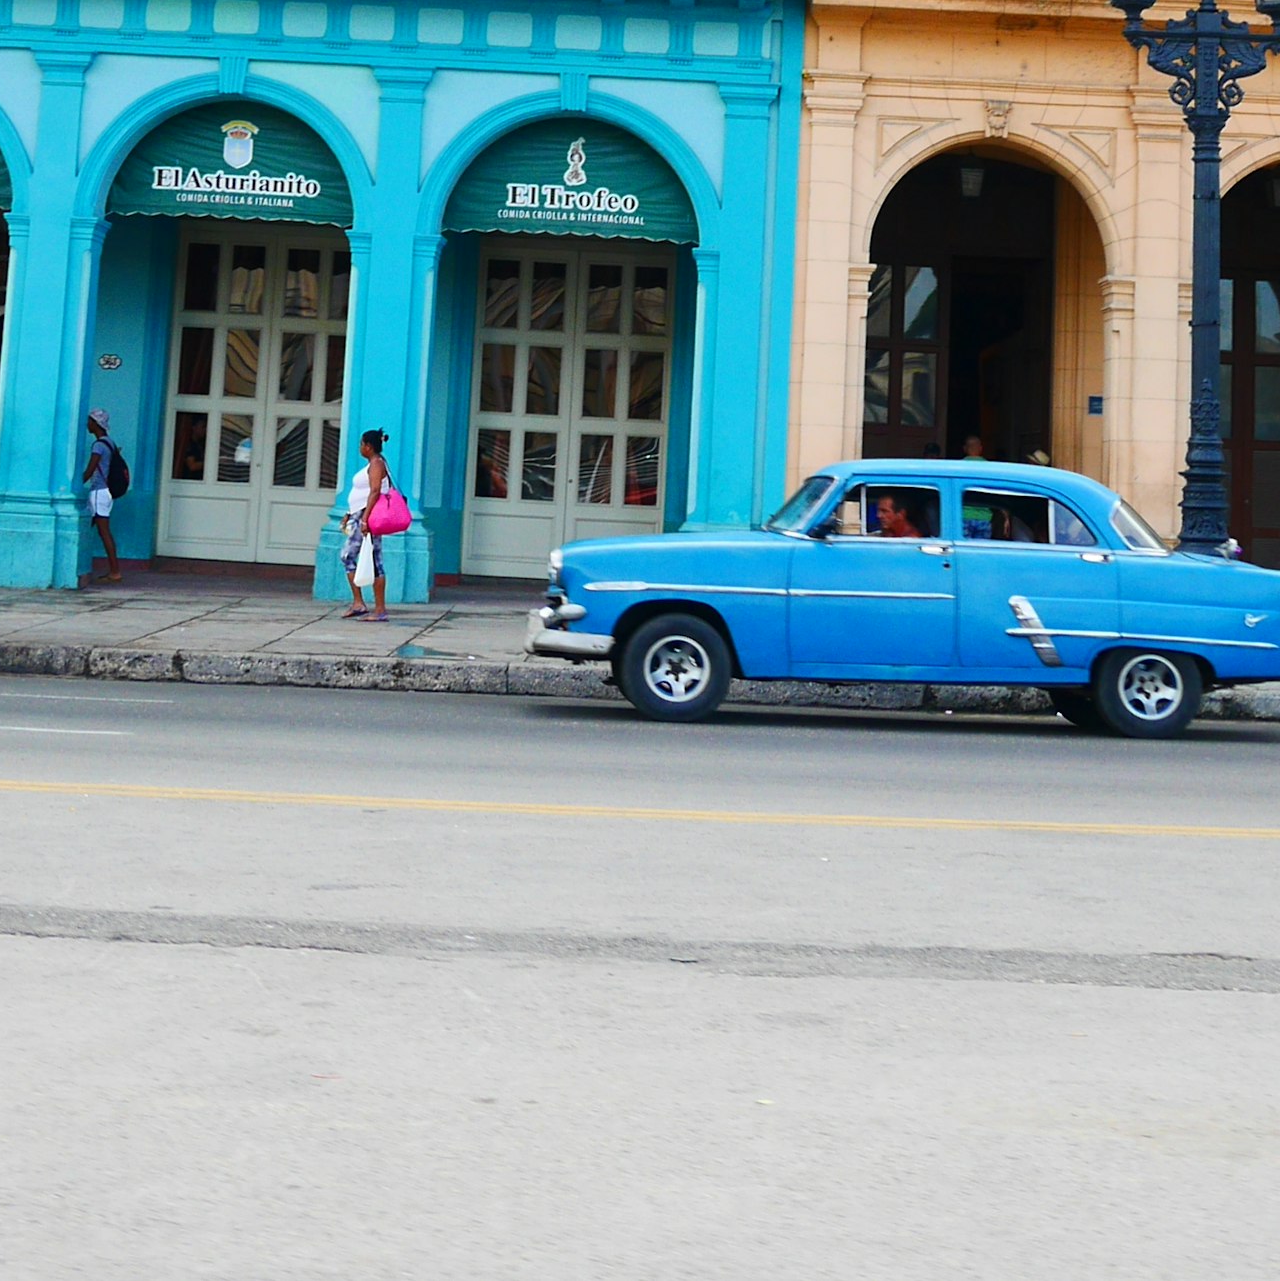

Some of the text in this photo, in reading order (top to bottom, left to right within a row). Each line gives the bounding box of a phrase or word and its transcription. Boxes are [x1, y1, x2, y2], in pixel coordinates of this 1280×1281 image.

[151, 166, 321, 198] El Asturianito
[176, 193, 294, 208] COMIDA CRIOLLA & ITALIANA
[505, 183, 640, 213] El Trofeo
[497, 209, 645, 225] COMIDA CRIOLLA & INTERNACIONAL
